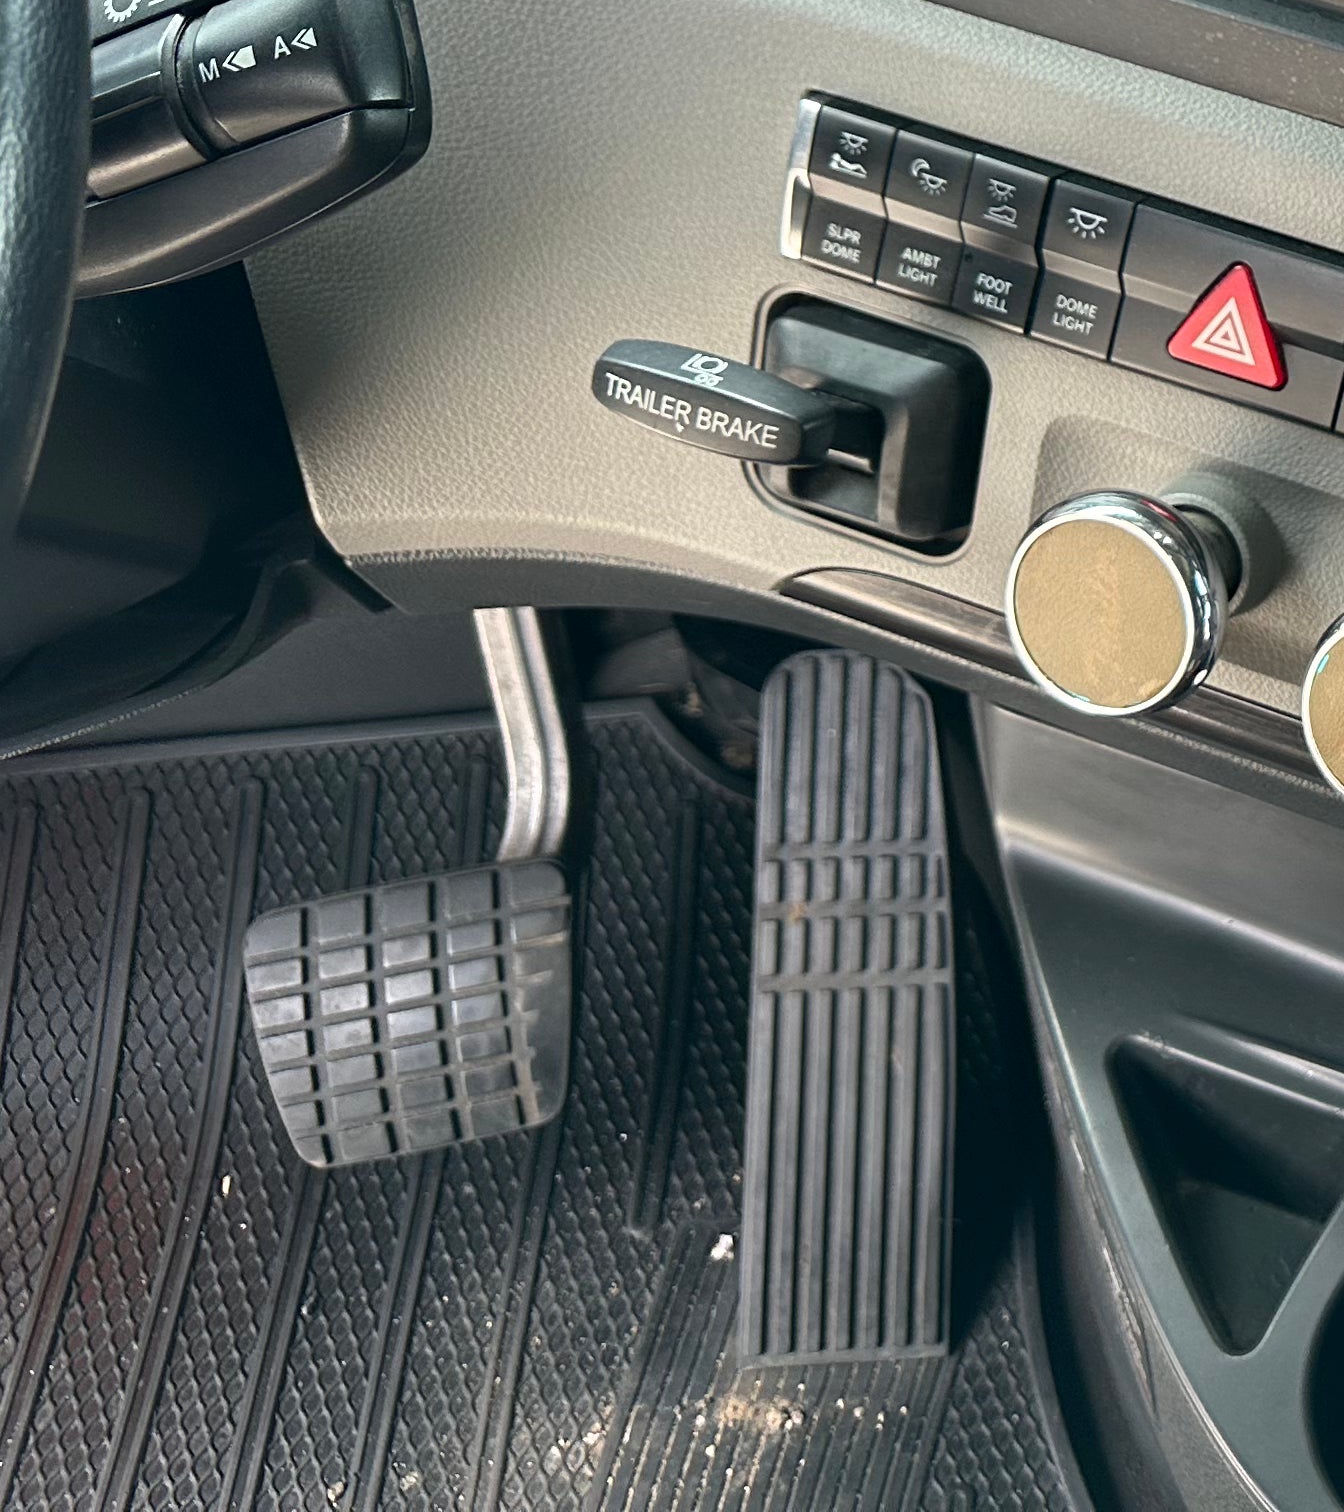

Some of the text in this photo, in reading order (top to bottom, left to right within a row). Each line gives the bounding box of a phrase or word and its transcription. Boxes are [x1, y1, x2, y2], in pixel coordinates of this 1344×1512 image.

[826, 222, 861, 246] SLPR
[820, 239, 861, 265] DOME
[901, 247, 941, 270] AMBT
[898, 264, 938, 287] LIGHT
[976, 272, 1013, 296] FOOT
[972, 290, 1009, 314] WELL
[1056, 294, 1098, 320] DOME
[1052, 312, 1094, 336] LIGHT
[605, 372, 780, 449] TRAILER BRAKE
